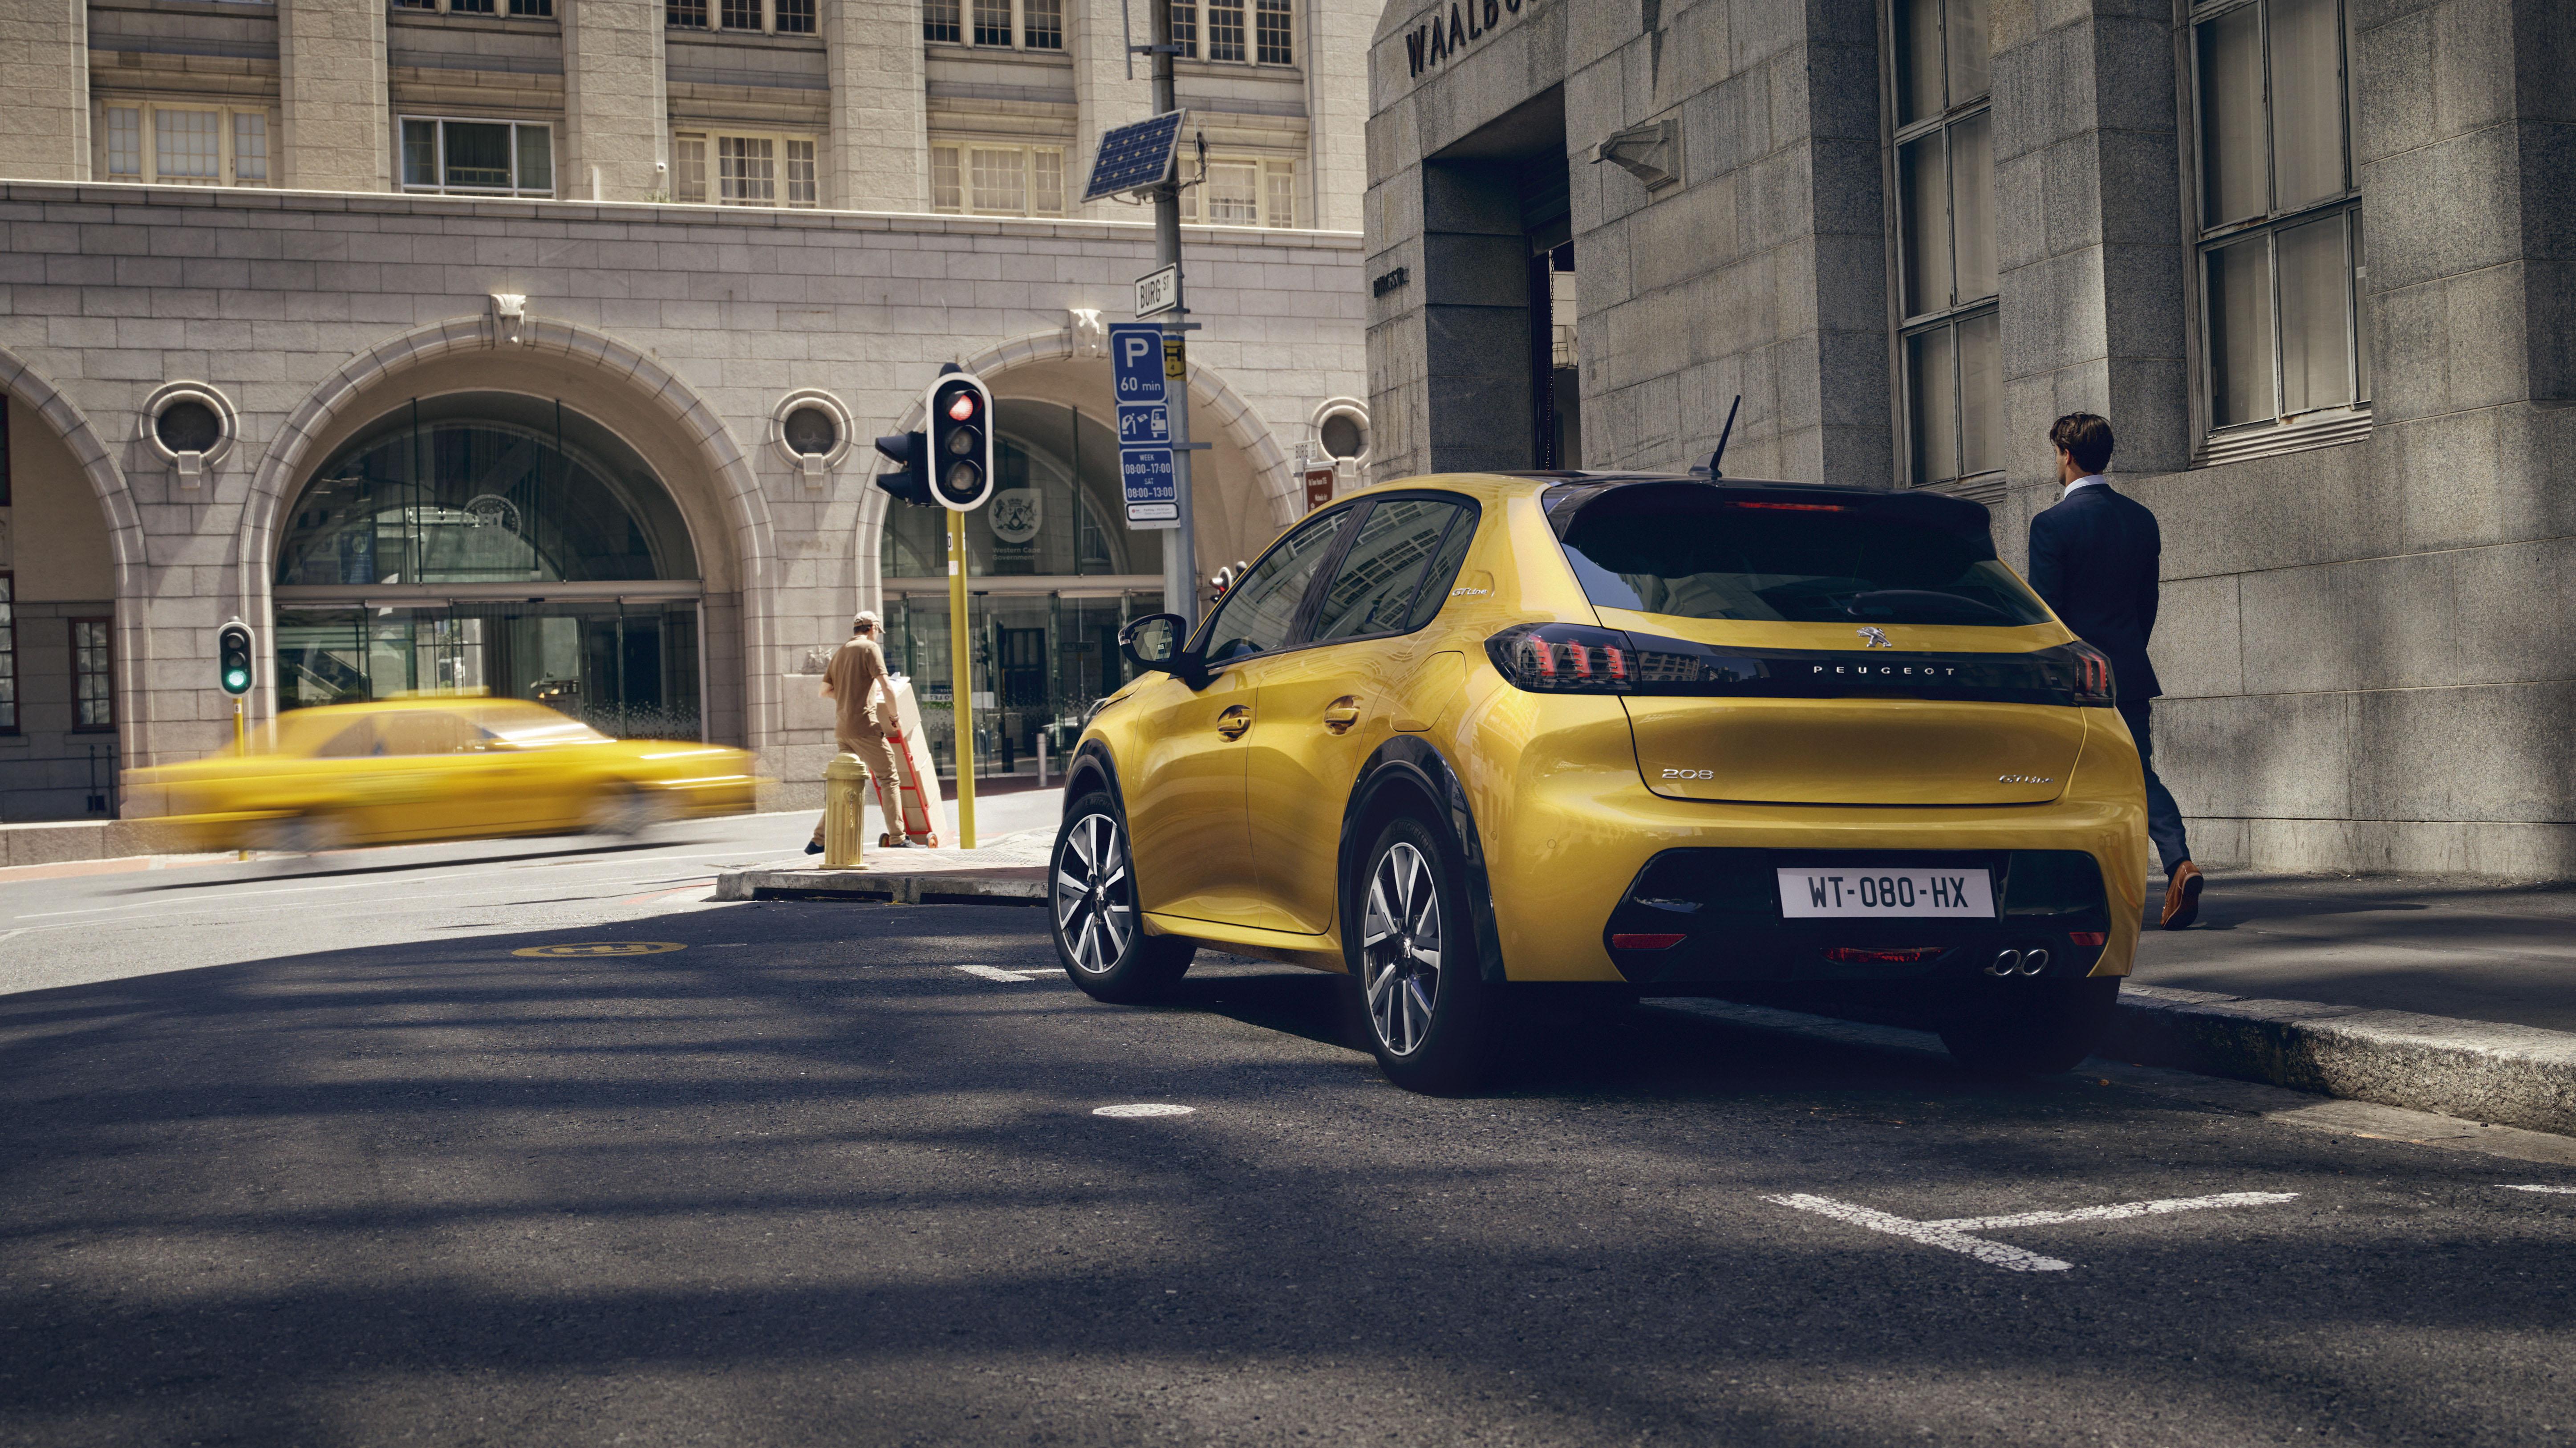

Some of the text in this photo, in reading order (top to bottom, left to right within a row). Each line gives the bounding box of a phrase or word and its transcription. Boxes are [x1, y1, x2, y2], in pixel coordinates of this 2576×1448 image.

[1405, 0, 1540, 78] WAALB
[1140, 275, 1169, 309] BURG ST
[1125, 338, 1149, 367] P
[1121, 377, 1161, 391] 60 min
[1814, 666, 1954, 675] PEUGEOT
[1662, 769, 1714, 779] 208
[1397, 821, 1430, 849] MICHELIN
[1808, 877, 1969, 907] WT-080-HX
